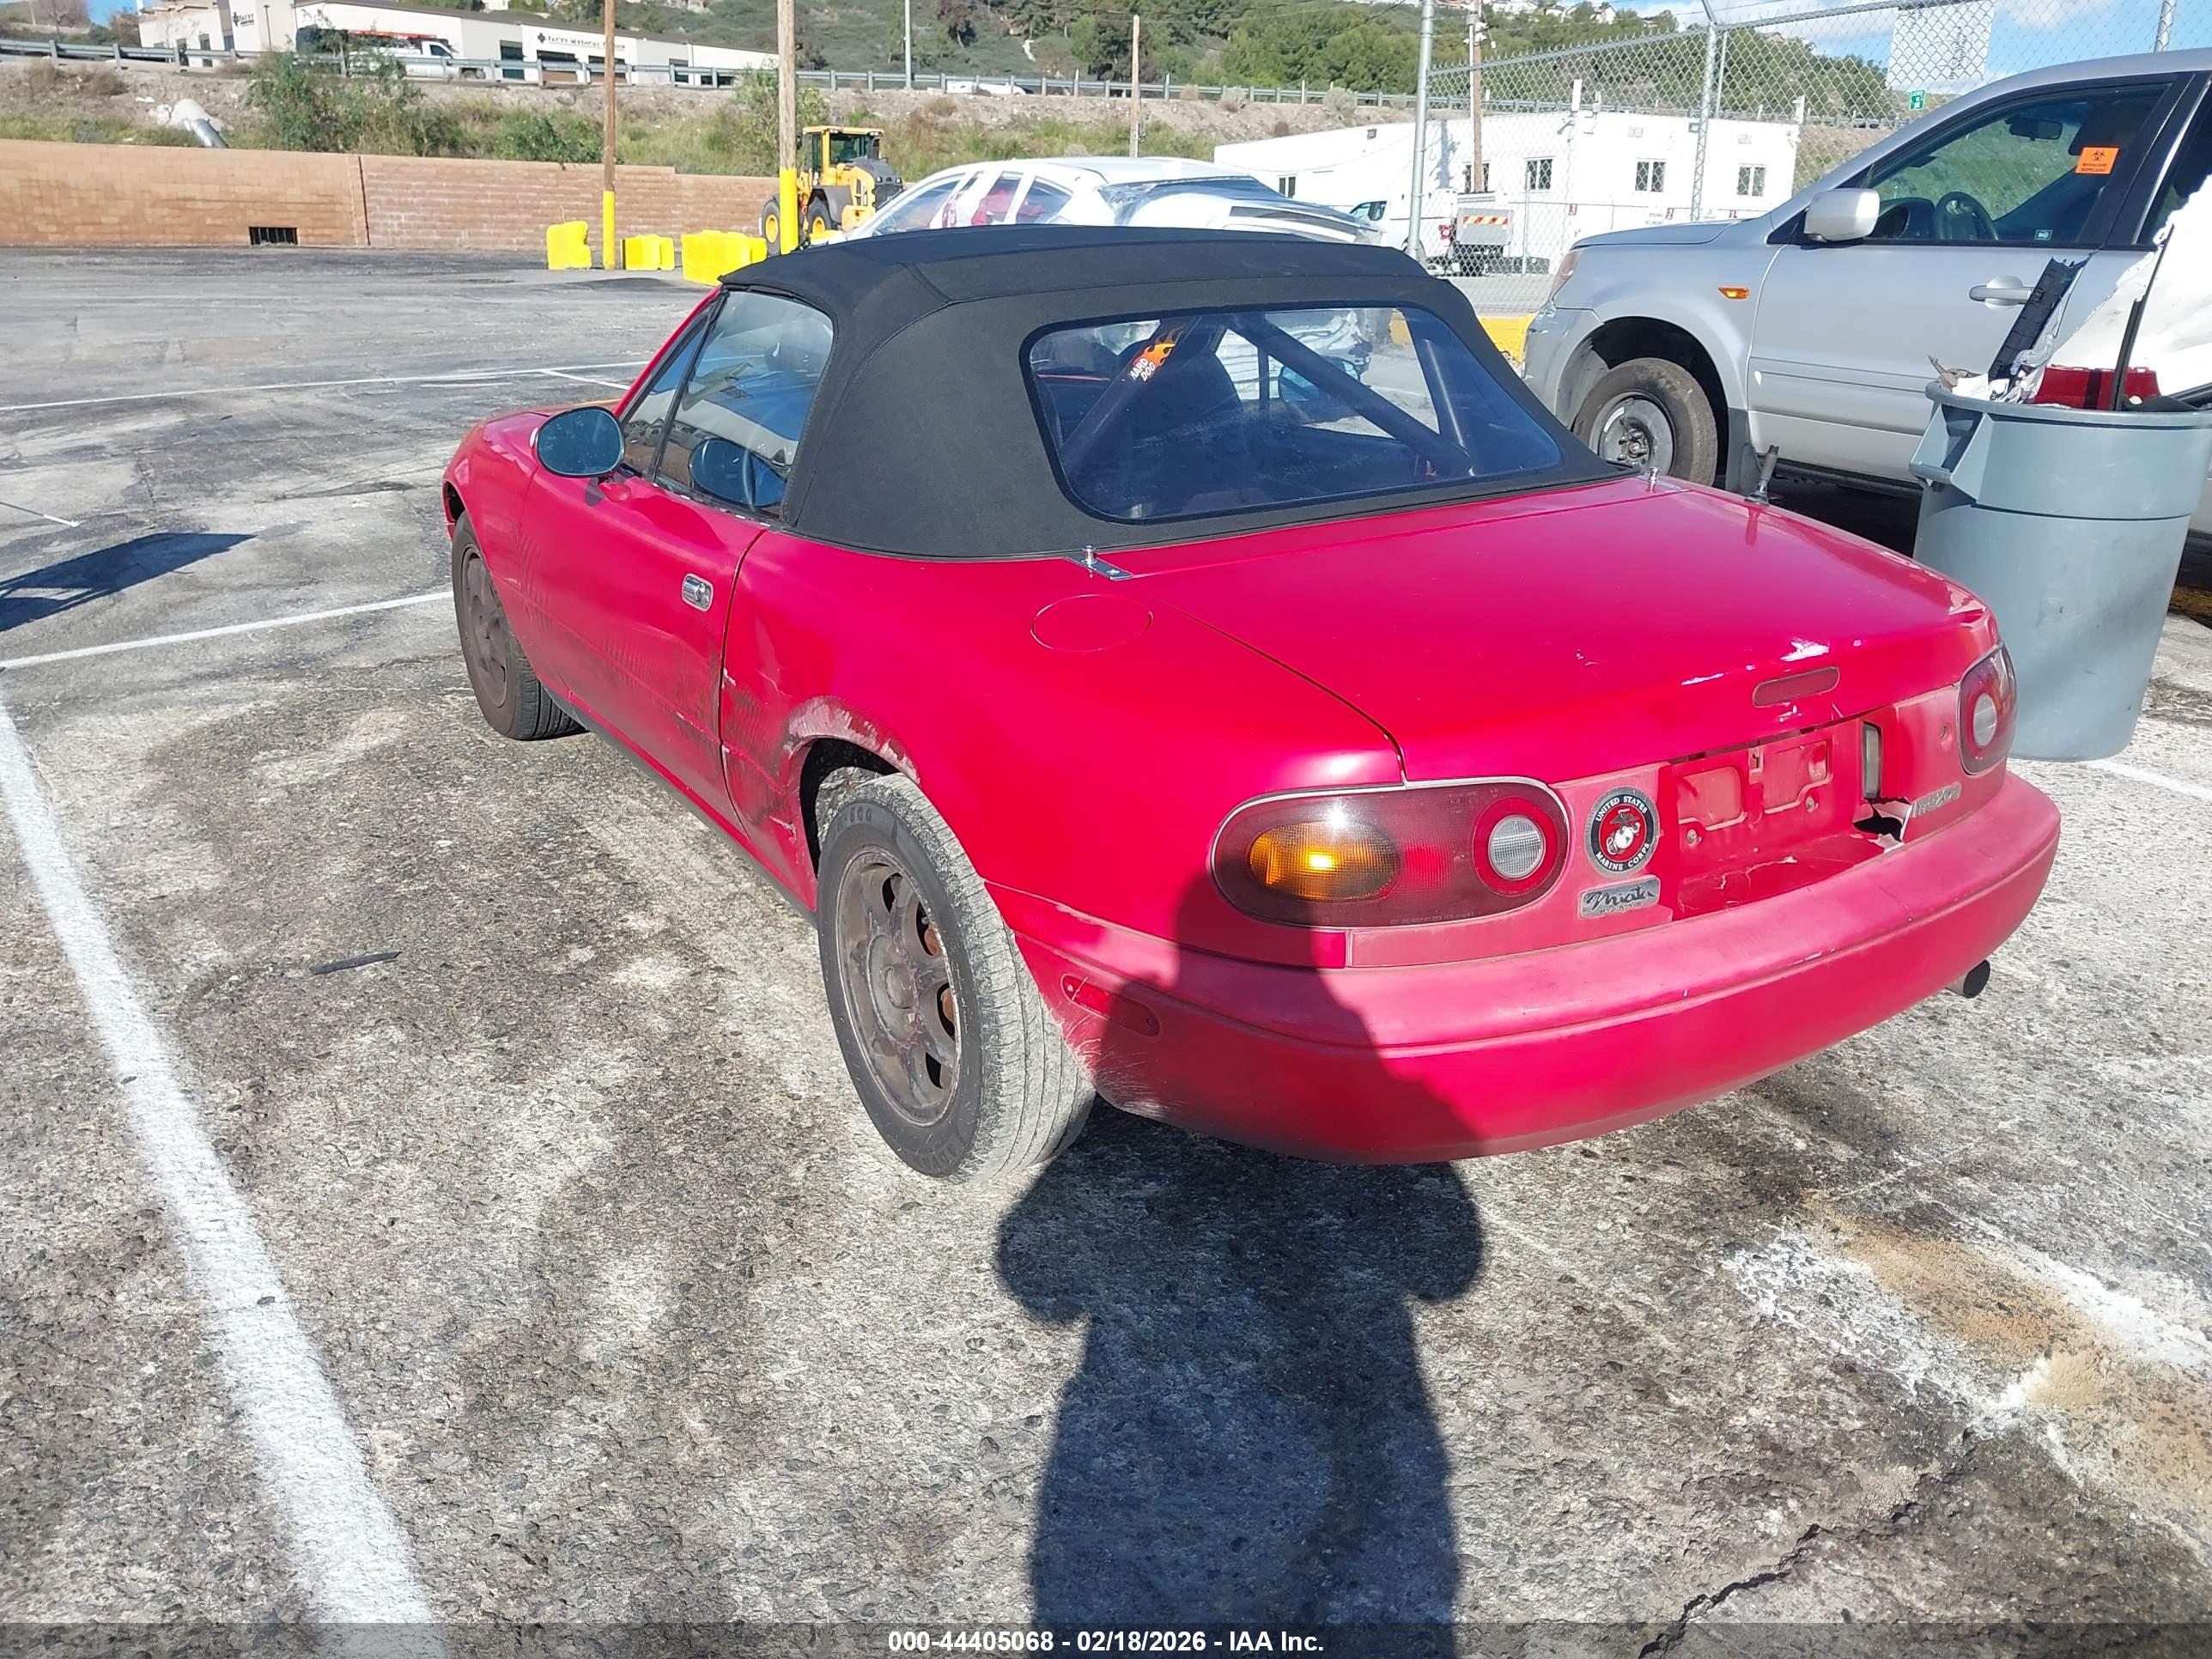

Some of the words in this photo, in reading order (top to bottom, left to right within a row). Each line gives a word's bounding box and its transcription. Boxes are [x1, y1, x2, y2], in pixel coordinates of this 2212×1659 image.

[1130, 357, 1149, 380] HARD
[1140, 362, 1156, 382] DOG
[1595, 796, 1620, 822] UNITED
[1623, 796, 1648, 814] STATES
[1595, 851, 1624, 871] MARINE
[1627, 842, 1650, 868] CORPS
[1586, 885, 1656, 911] Miata
